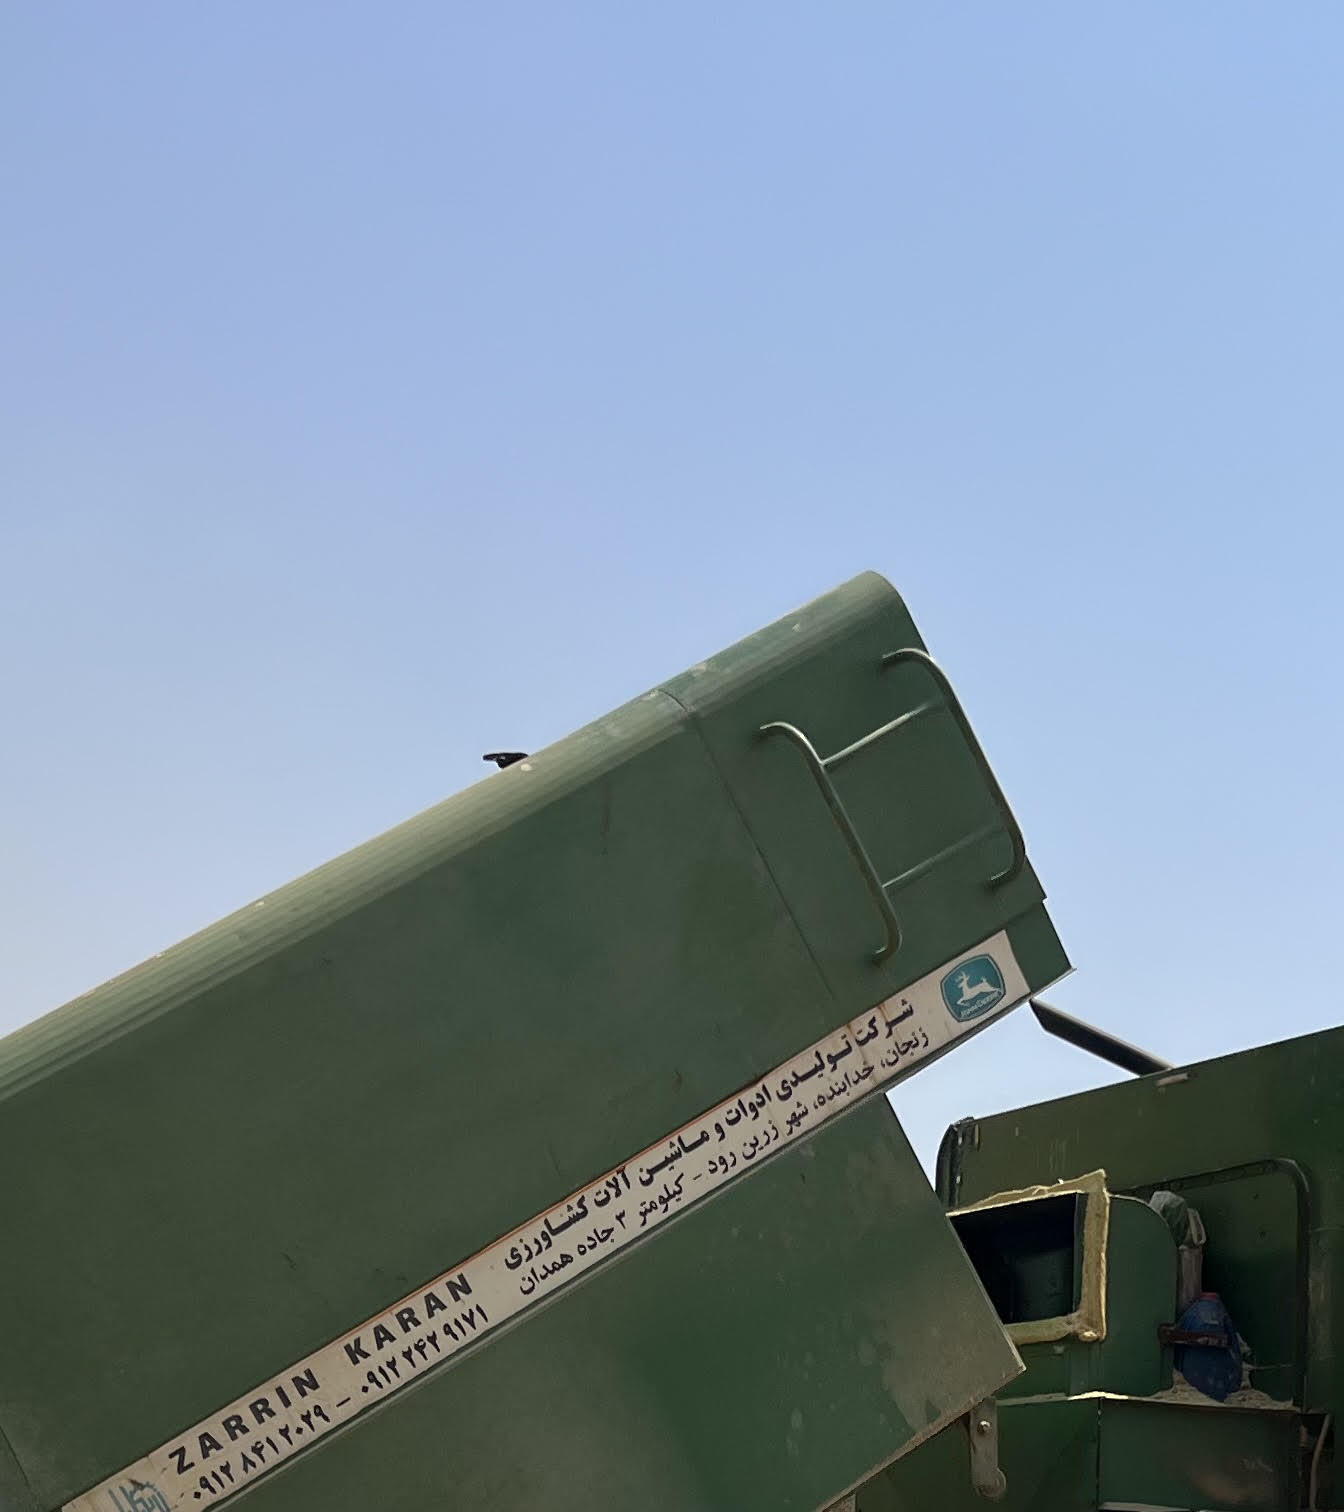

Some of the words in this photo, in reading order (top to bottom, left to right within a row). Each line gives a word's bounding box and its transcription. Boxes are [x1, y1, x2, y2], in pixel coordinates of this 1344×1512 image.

[853, 998, 914, 1047] شرکت
[775, 1033, 852, 1101] تولیدی
[724, 1083, 772, 1126] ادوات
[785, 1100, 809, 1136] شهر
[713, 1122, 725, 1142] و
[741, 1119, 779, 1160] زرین
[638, 1129, 710, 1187] ماشین
[707, 1151, 737, 1174] رود
[614, 1208, 627, 1230] ۳
[638, 1171, 684, 1227] کیلومتر
[503, 1194, 589, 1270] کشاورزی
[576, 1226, 614, 1256] جاده
[519, 1252, 574, 1295] همدان
[167, 1367, 320, 1475] ZARRIN
[343, 1272, 472, 1366] KARAN
